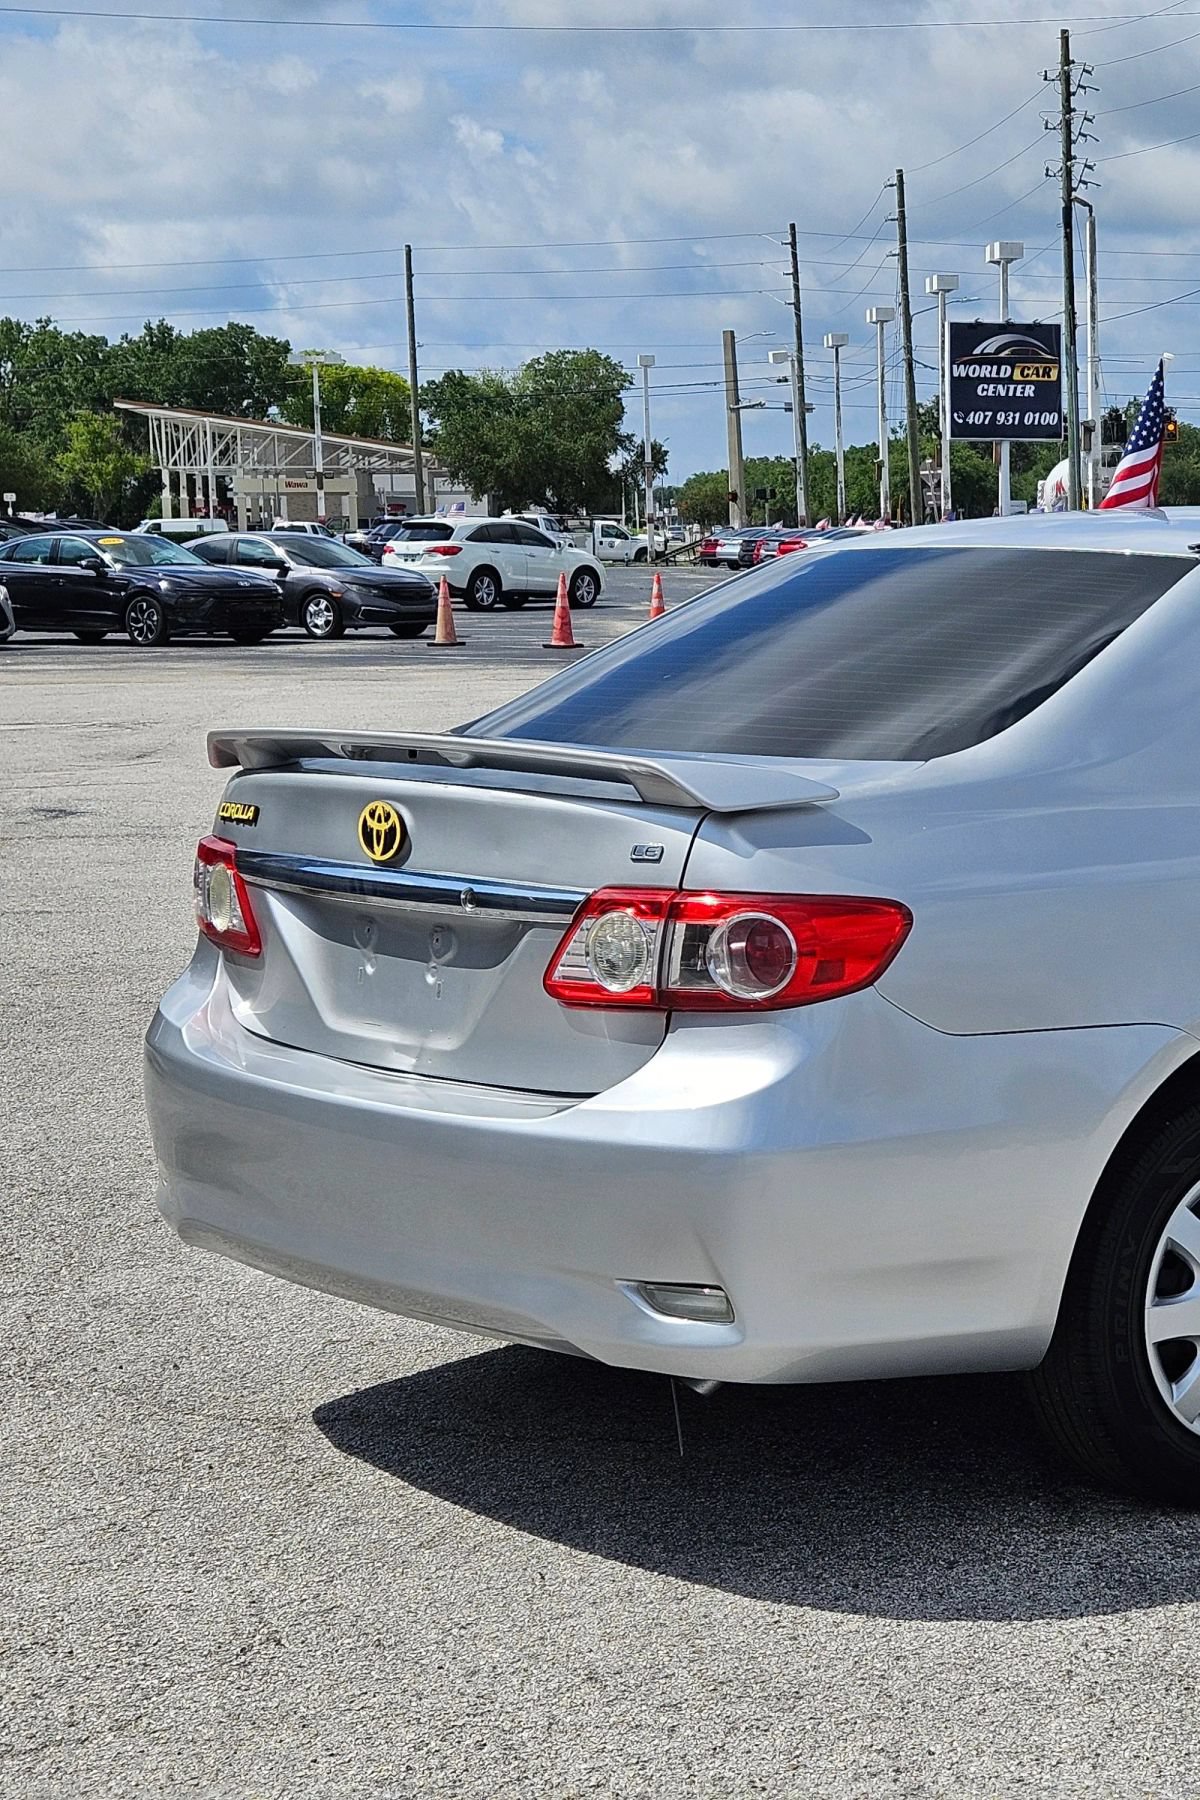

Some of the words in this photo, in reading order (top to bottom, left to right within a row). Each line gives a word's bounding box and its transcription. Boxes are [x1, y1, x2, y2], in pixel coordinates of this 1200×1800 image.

[952, 364, 1012, 378] WORLD
[1019, 365, 1053, 379] CAR
[976, 383, 1036, 397] CENTER
[966, 411, 993, 425] 407
[995, 411, 1020, 425] 931
[1024, 412, 1058, 426] 0100
[284, 480, 308, 489] Wawa
[218, 802, 255, 820] COROLLA
[631, 844, 660, 858] LE
